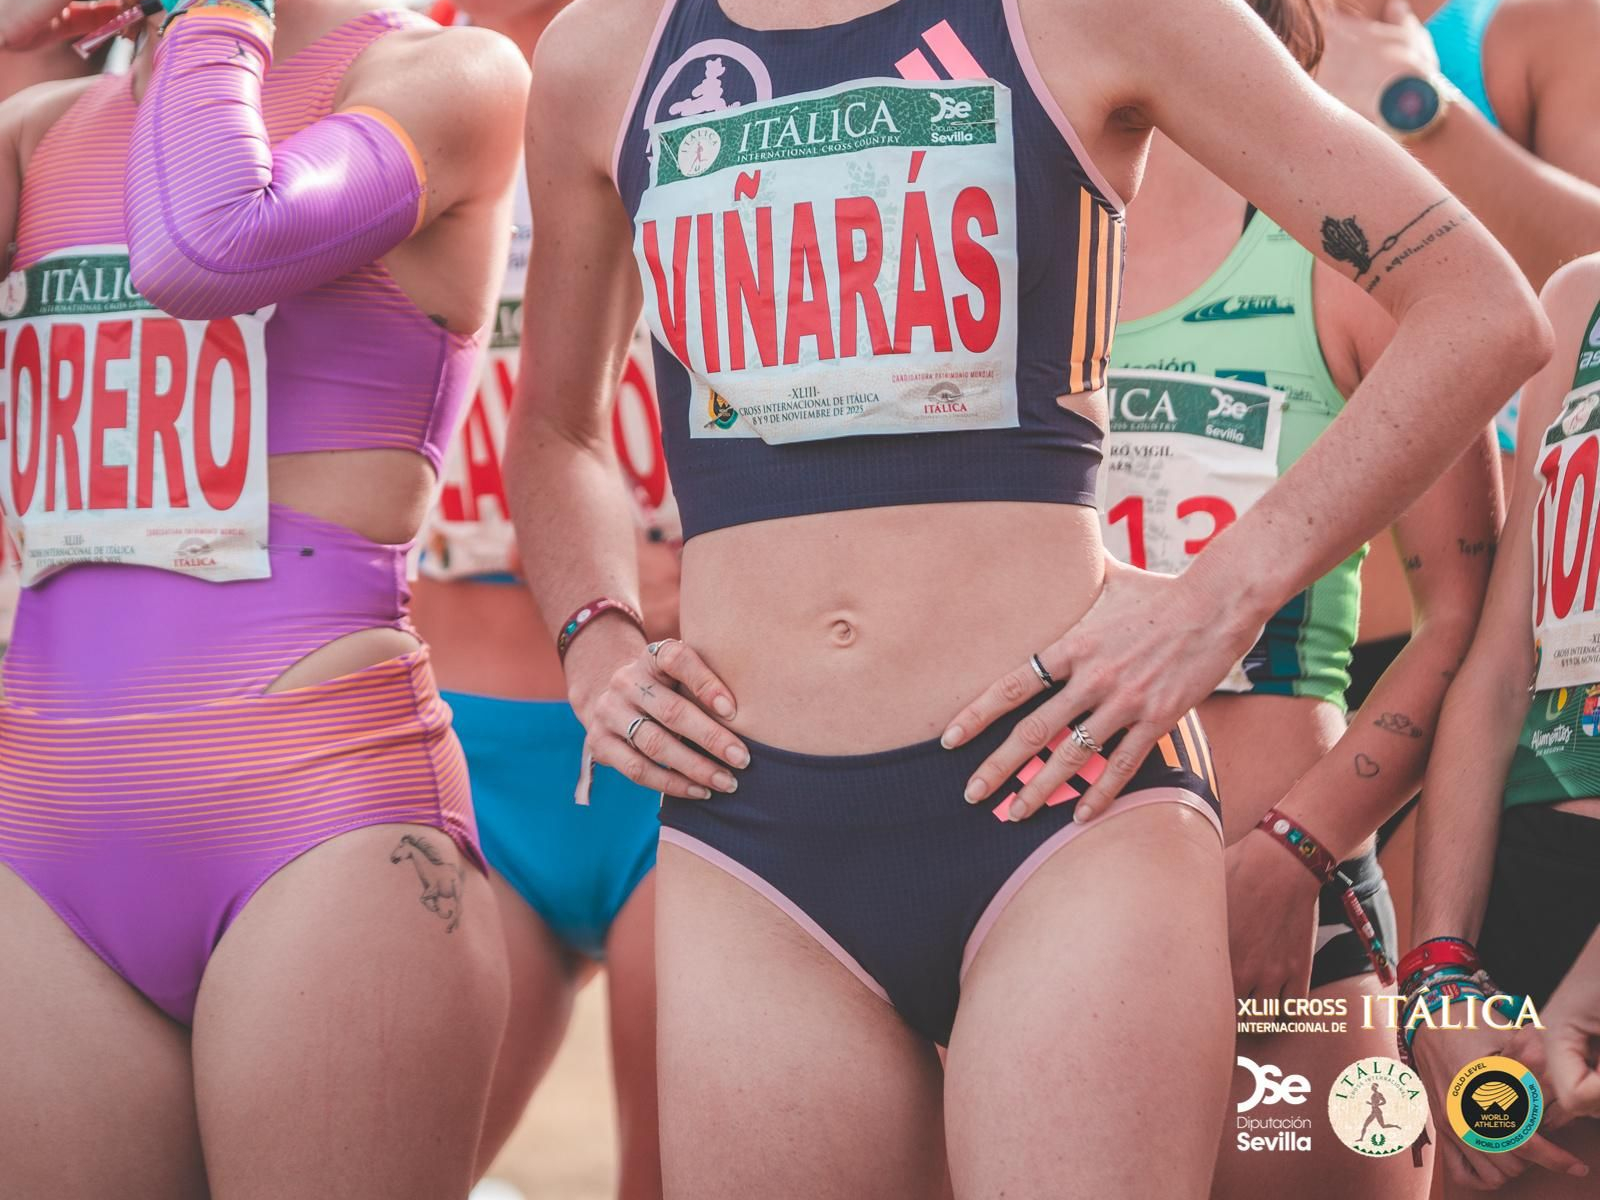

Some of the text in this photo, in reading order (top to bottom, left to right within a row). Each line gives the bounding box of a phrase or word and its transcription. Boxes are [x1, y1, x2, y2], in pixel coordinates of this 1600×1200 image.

[738, 99, 901, 152] ITÁLICA
[931, 131, 973, 143] Sevilla
[737, 135, 901, 163] INTERNATIONAL CROSS COUNTRY
[643, 151, 1000, 374] VIÑARÁS
[738, 392, 880, 417] CROSS INTERNACIONAL DE ITÁLICA
[770, 413, 781, 424] DE
[782, 408, 831, 422] NOVIEMBRE
[833, 407, 844, 417] DE
[846, 405, 864, 415] 2025
[924, 402, 968, 414] ITÁLICA
[1205, 424, 1245, 443] Sevilla
